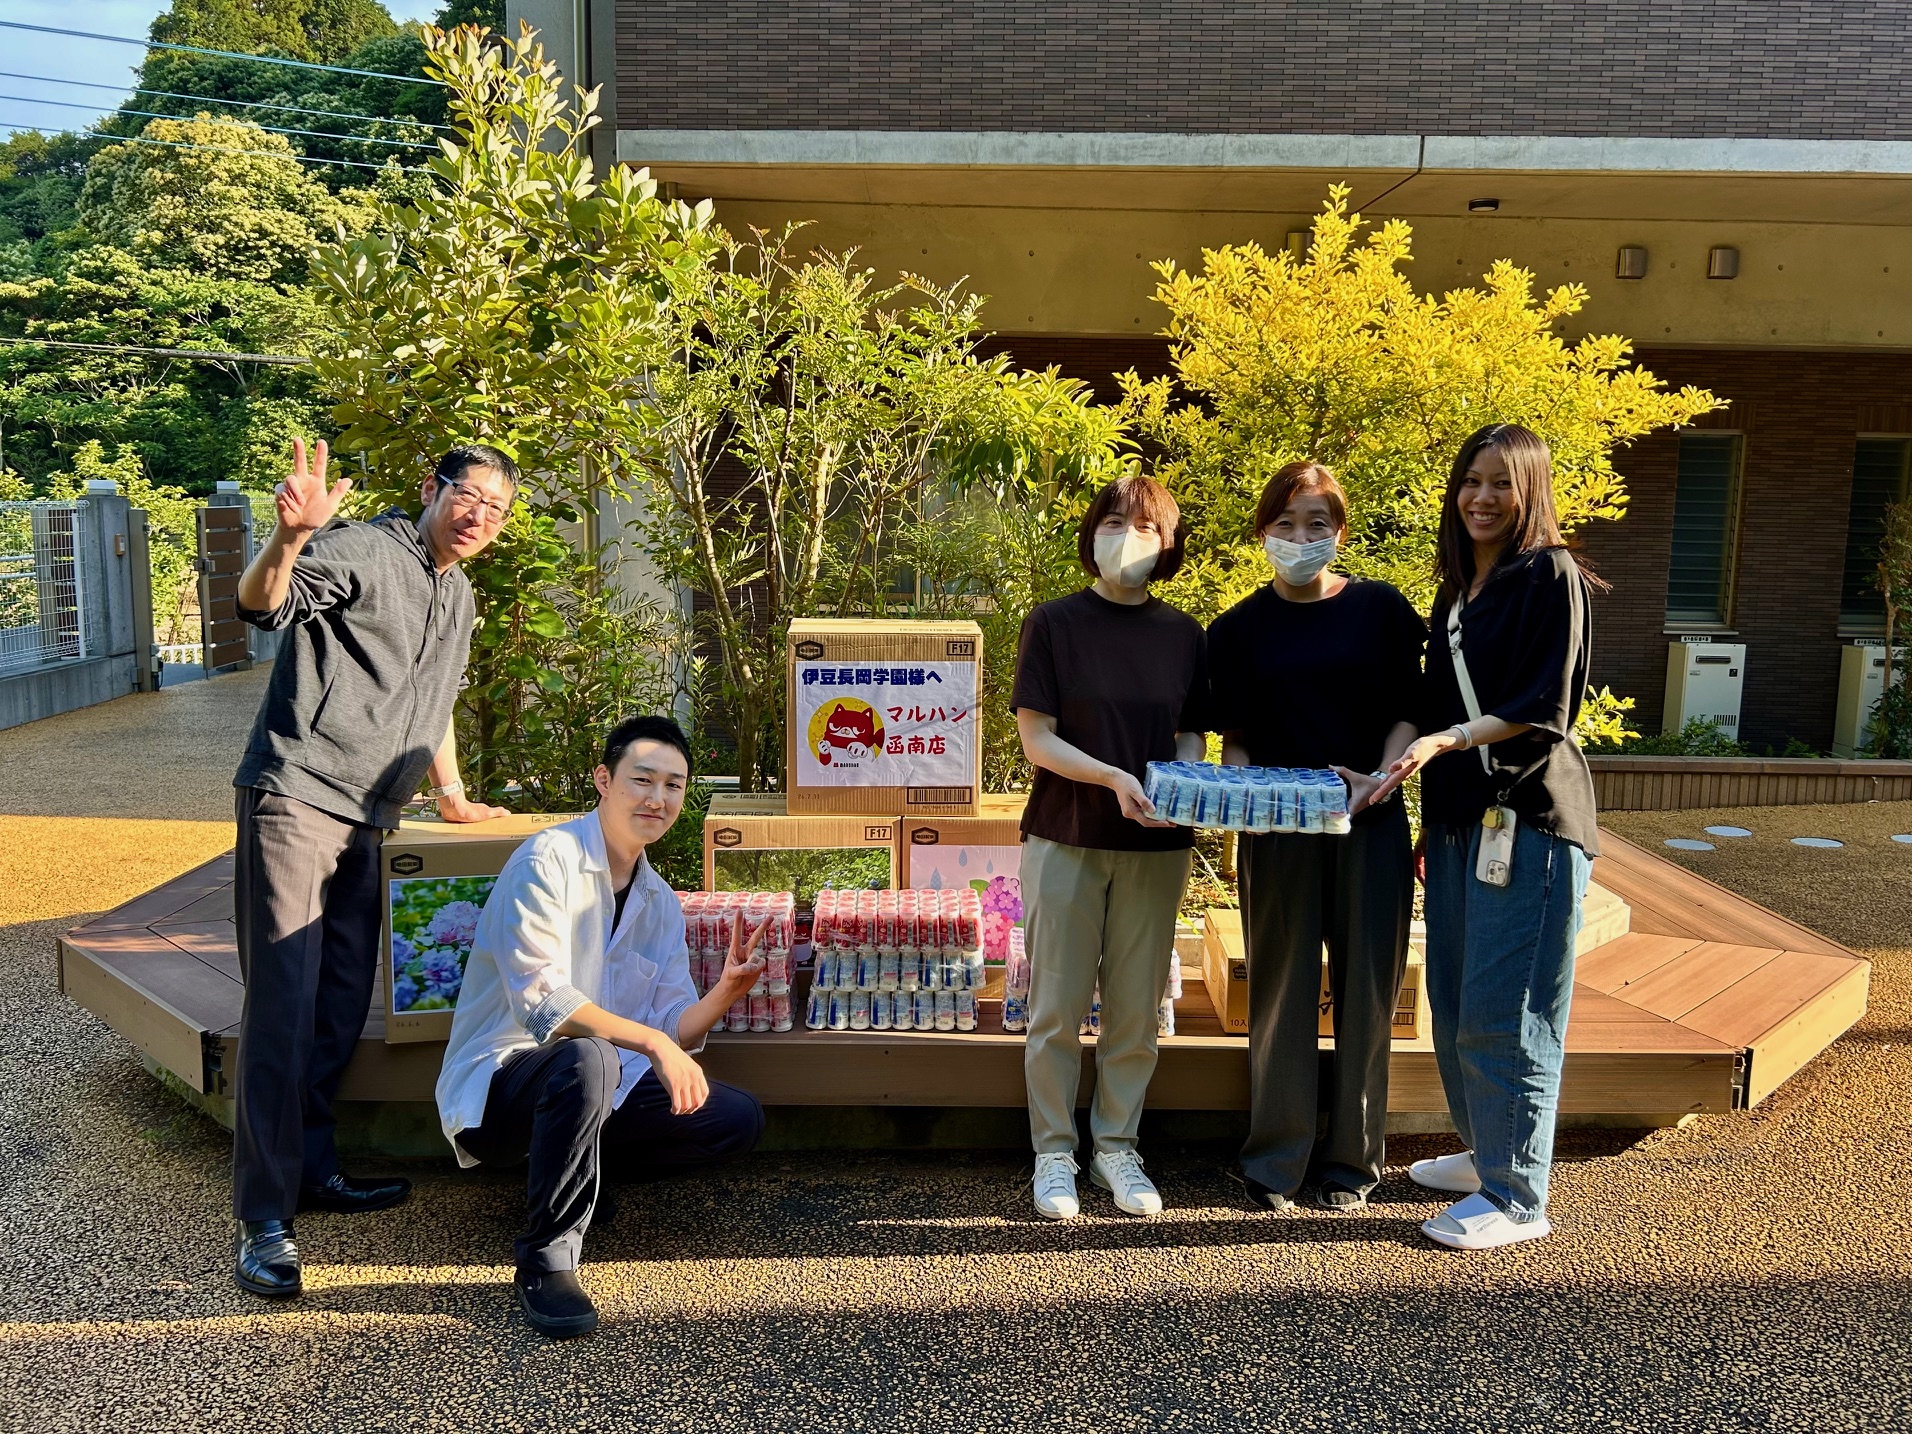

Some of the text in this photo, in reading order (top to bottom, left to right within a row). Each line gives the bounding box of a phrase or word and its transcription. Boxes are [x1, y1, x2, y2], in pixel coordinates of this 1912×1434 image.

[951, 643, 969, 654] F17
[802, 668, 943, 686] 伊豆長岡学園様へ
[886, 705, 968, 723] マルハン
[886, 735, 946, 755] 函南店
[870, 828, 887, 838] F17
